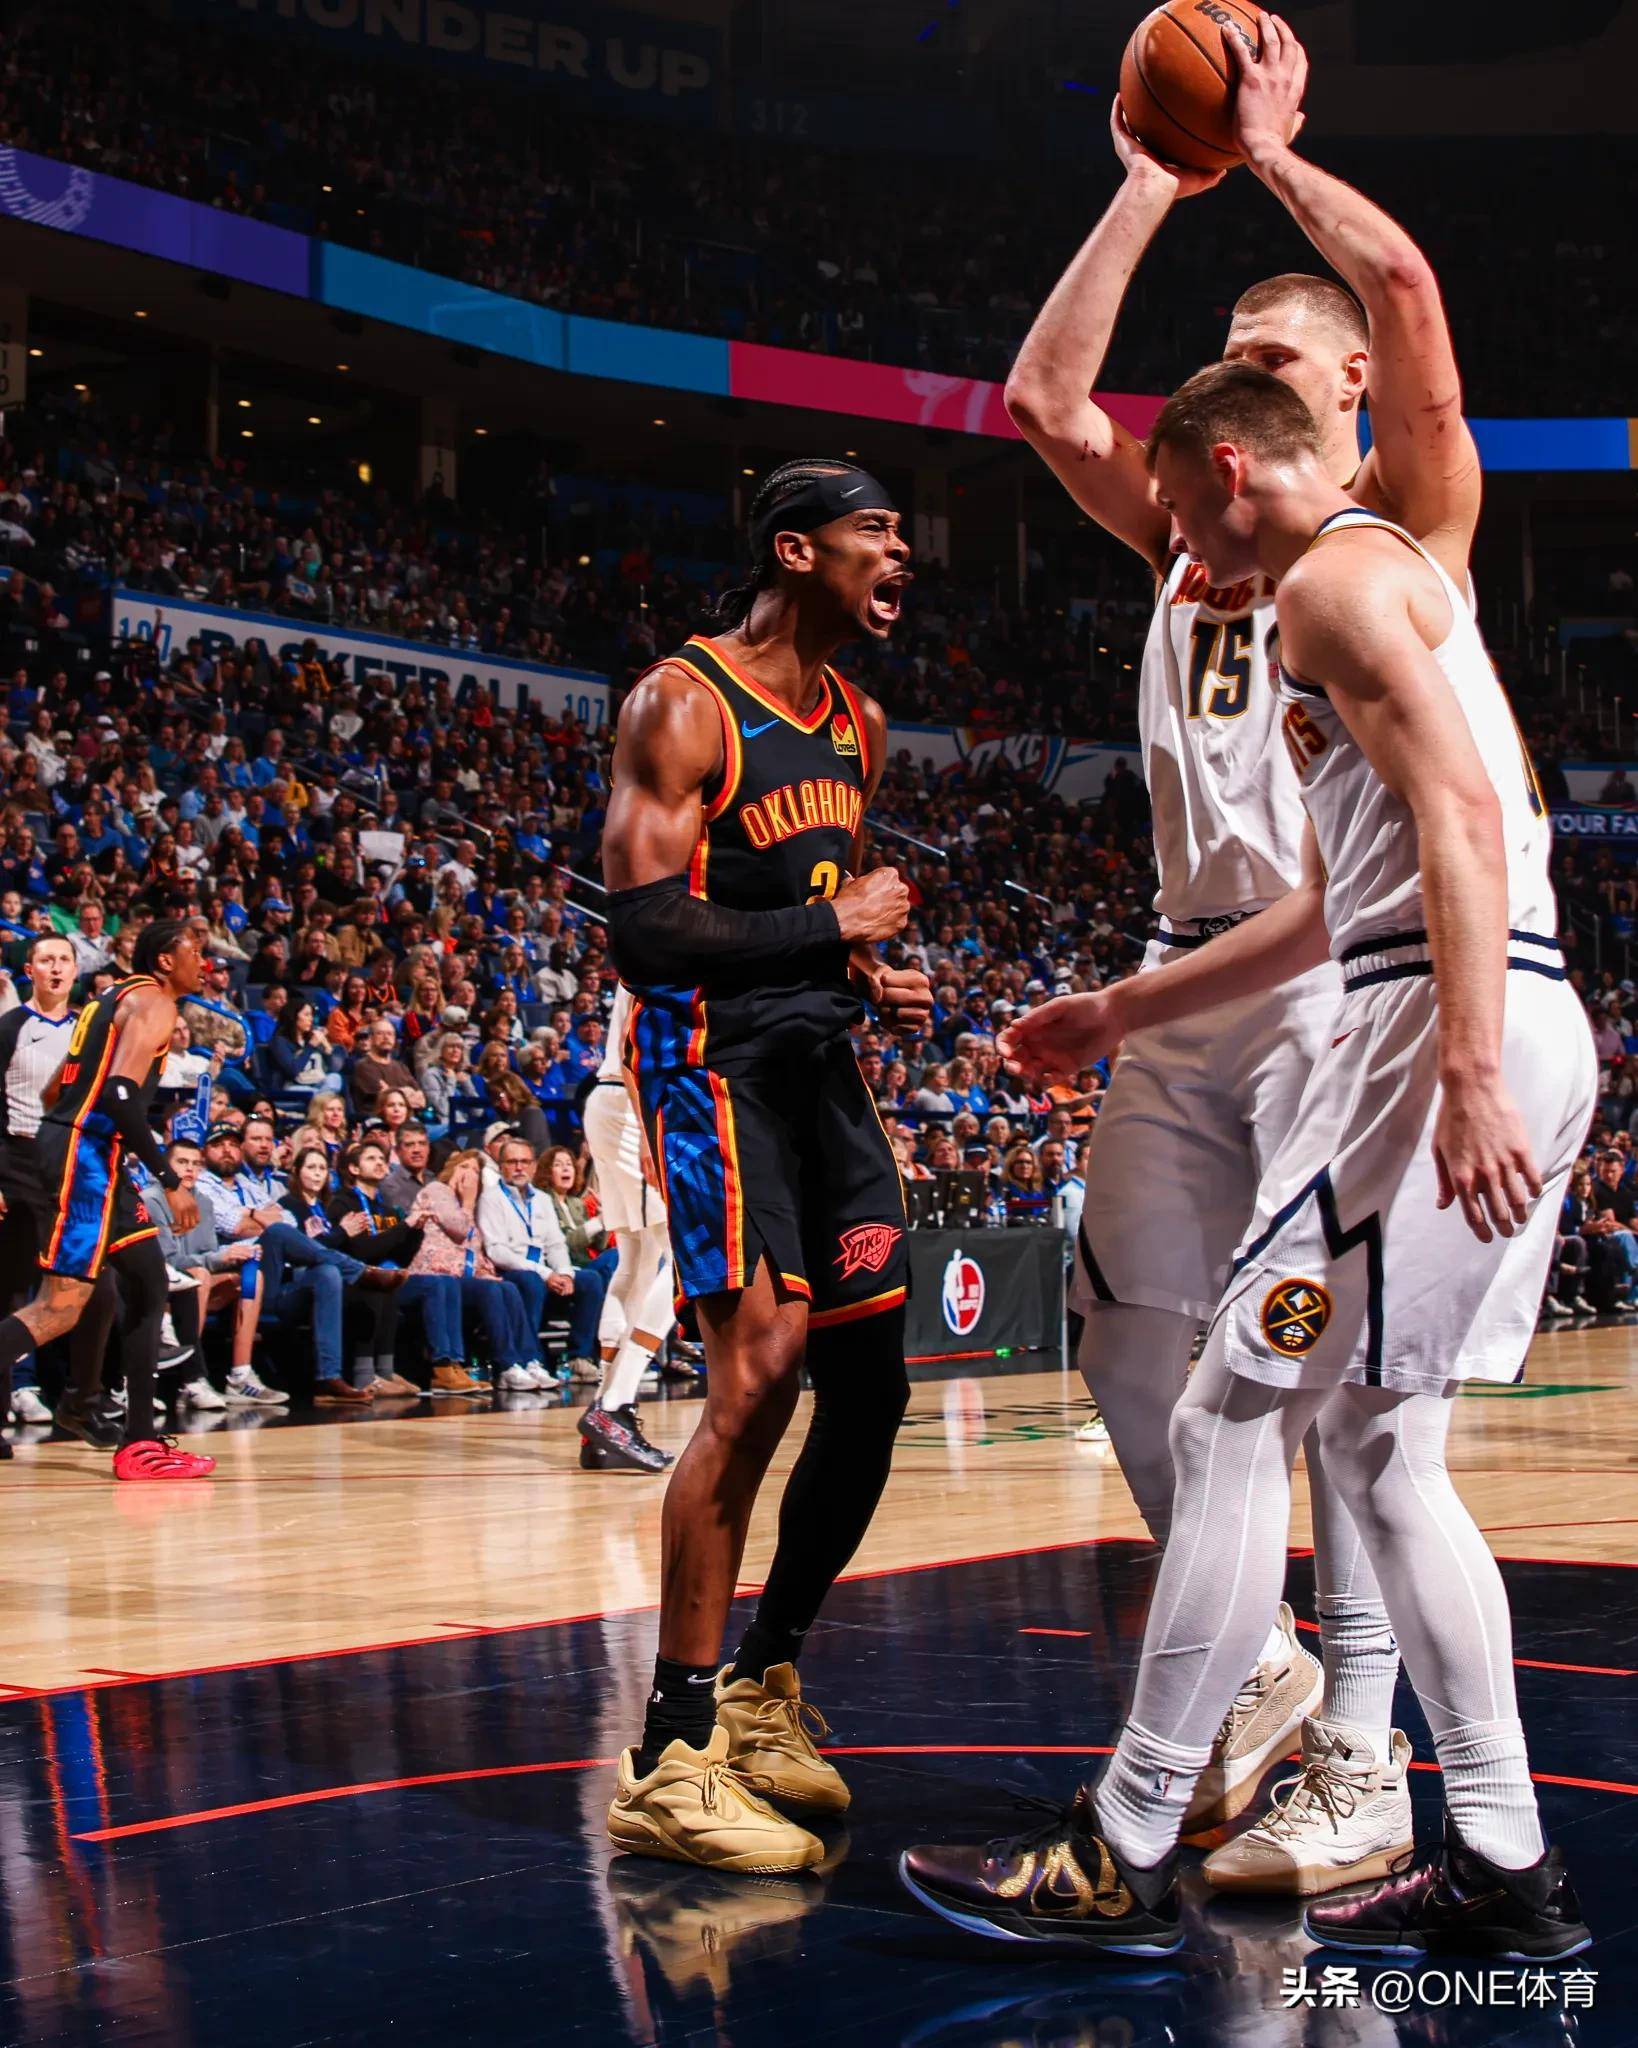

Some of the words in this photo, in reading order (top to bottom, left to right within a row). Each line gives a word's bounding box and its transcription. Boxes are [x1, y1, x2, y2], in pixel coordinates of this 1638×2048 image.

[606, 37, 710, 96] UP
[752, 99, 809, 135] 312
[1185, 615, 1254, 720] 15
[563, 692, 606, 729] 107
[804, 860, 839, 906] 2
